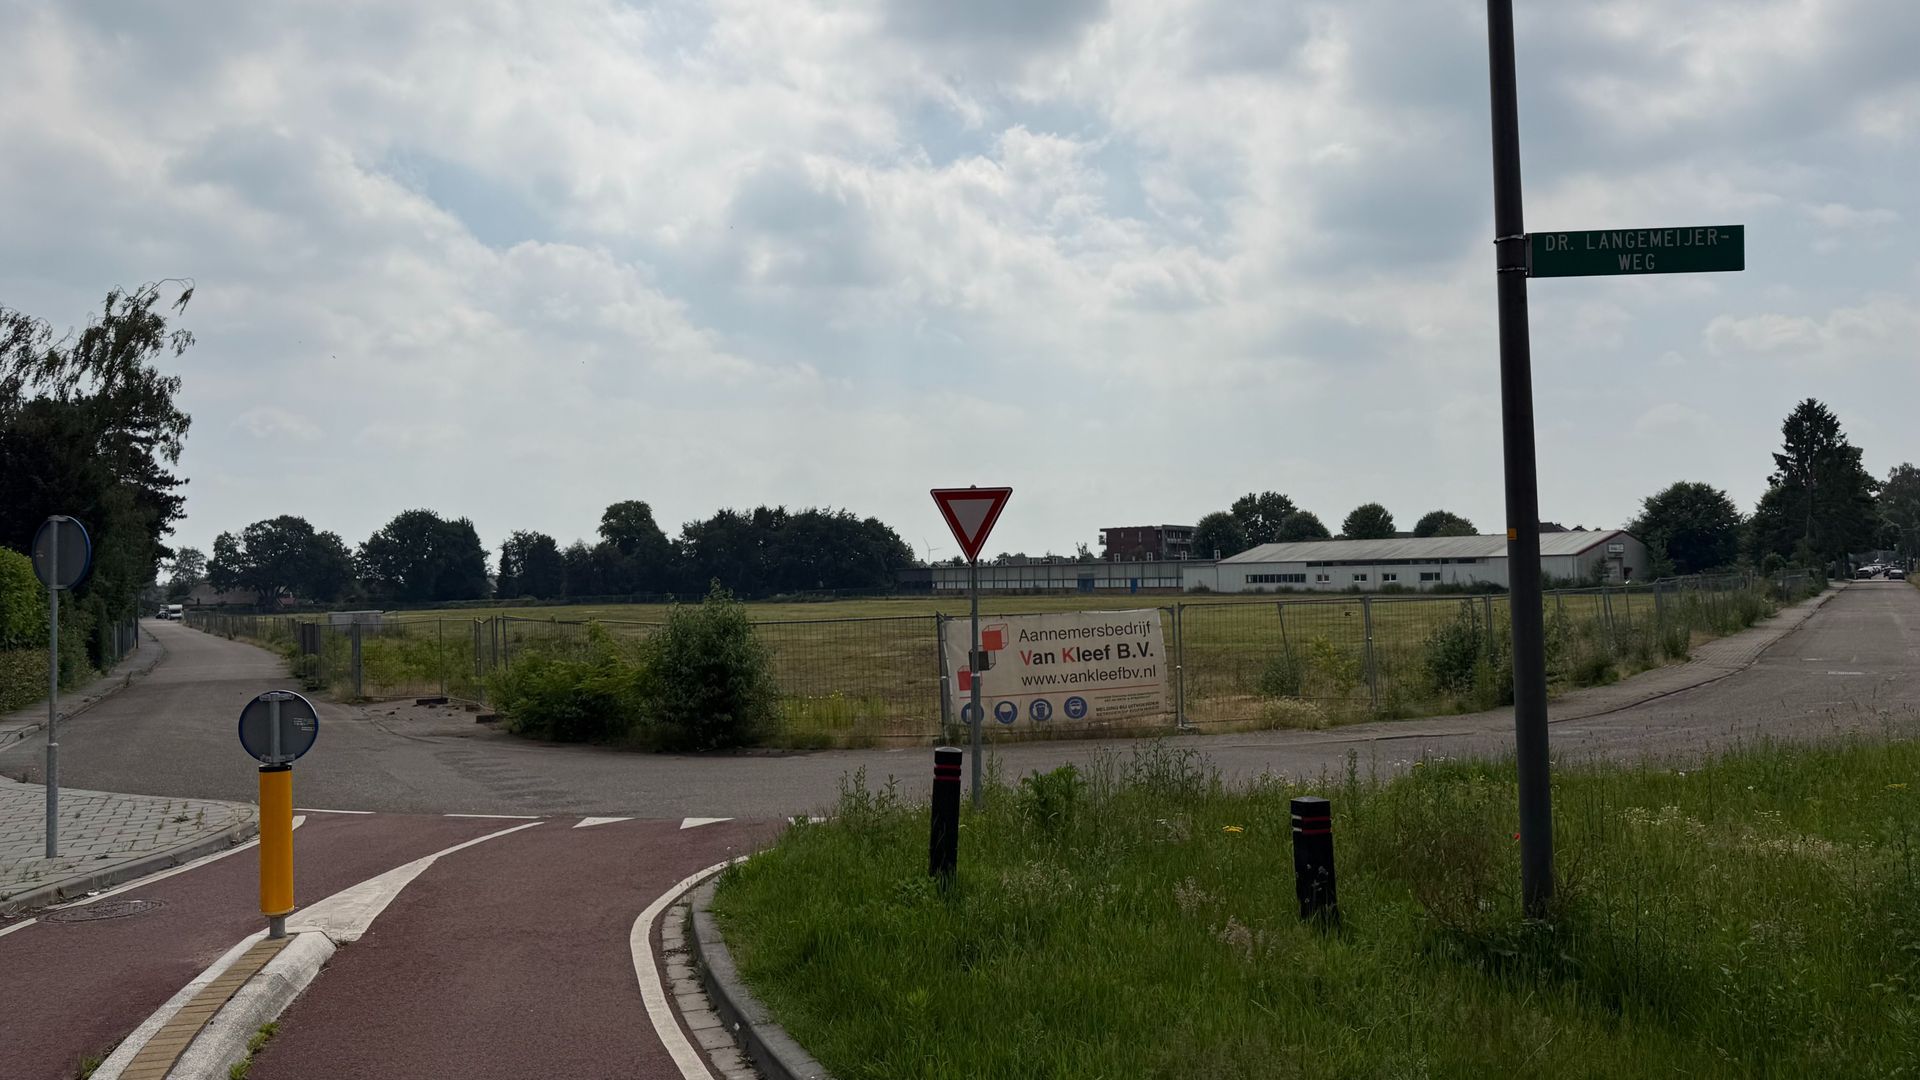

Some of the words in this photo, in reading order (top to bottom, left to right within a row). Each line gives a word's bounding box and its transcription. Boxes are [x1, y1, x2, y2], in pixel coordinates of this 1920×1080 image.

[1545, 234, 1575, 252] DR.
[1586, 228, 1730, 250] LANGEMEIJER-
[1618, 253, 1655, 271] WEG
[1018, 621, 1151, 643] Aannemersbedrijf
[1019, 650, 1055, 666] Van
[1062, 645, 1110, 663] Kleef
[1117, 642, 1154, 660] B.V.
[1021, 665, 1157, 687] www.vankleefbv.nl
